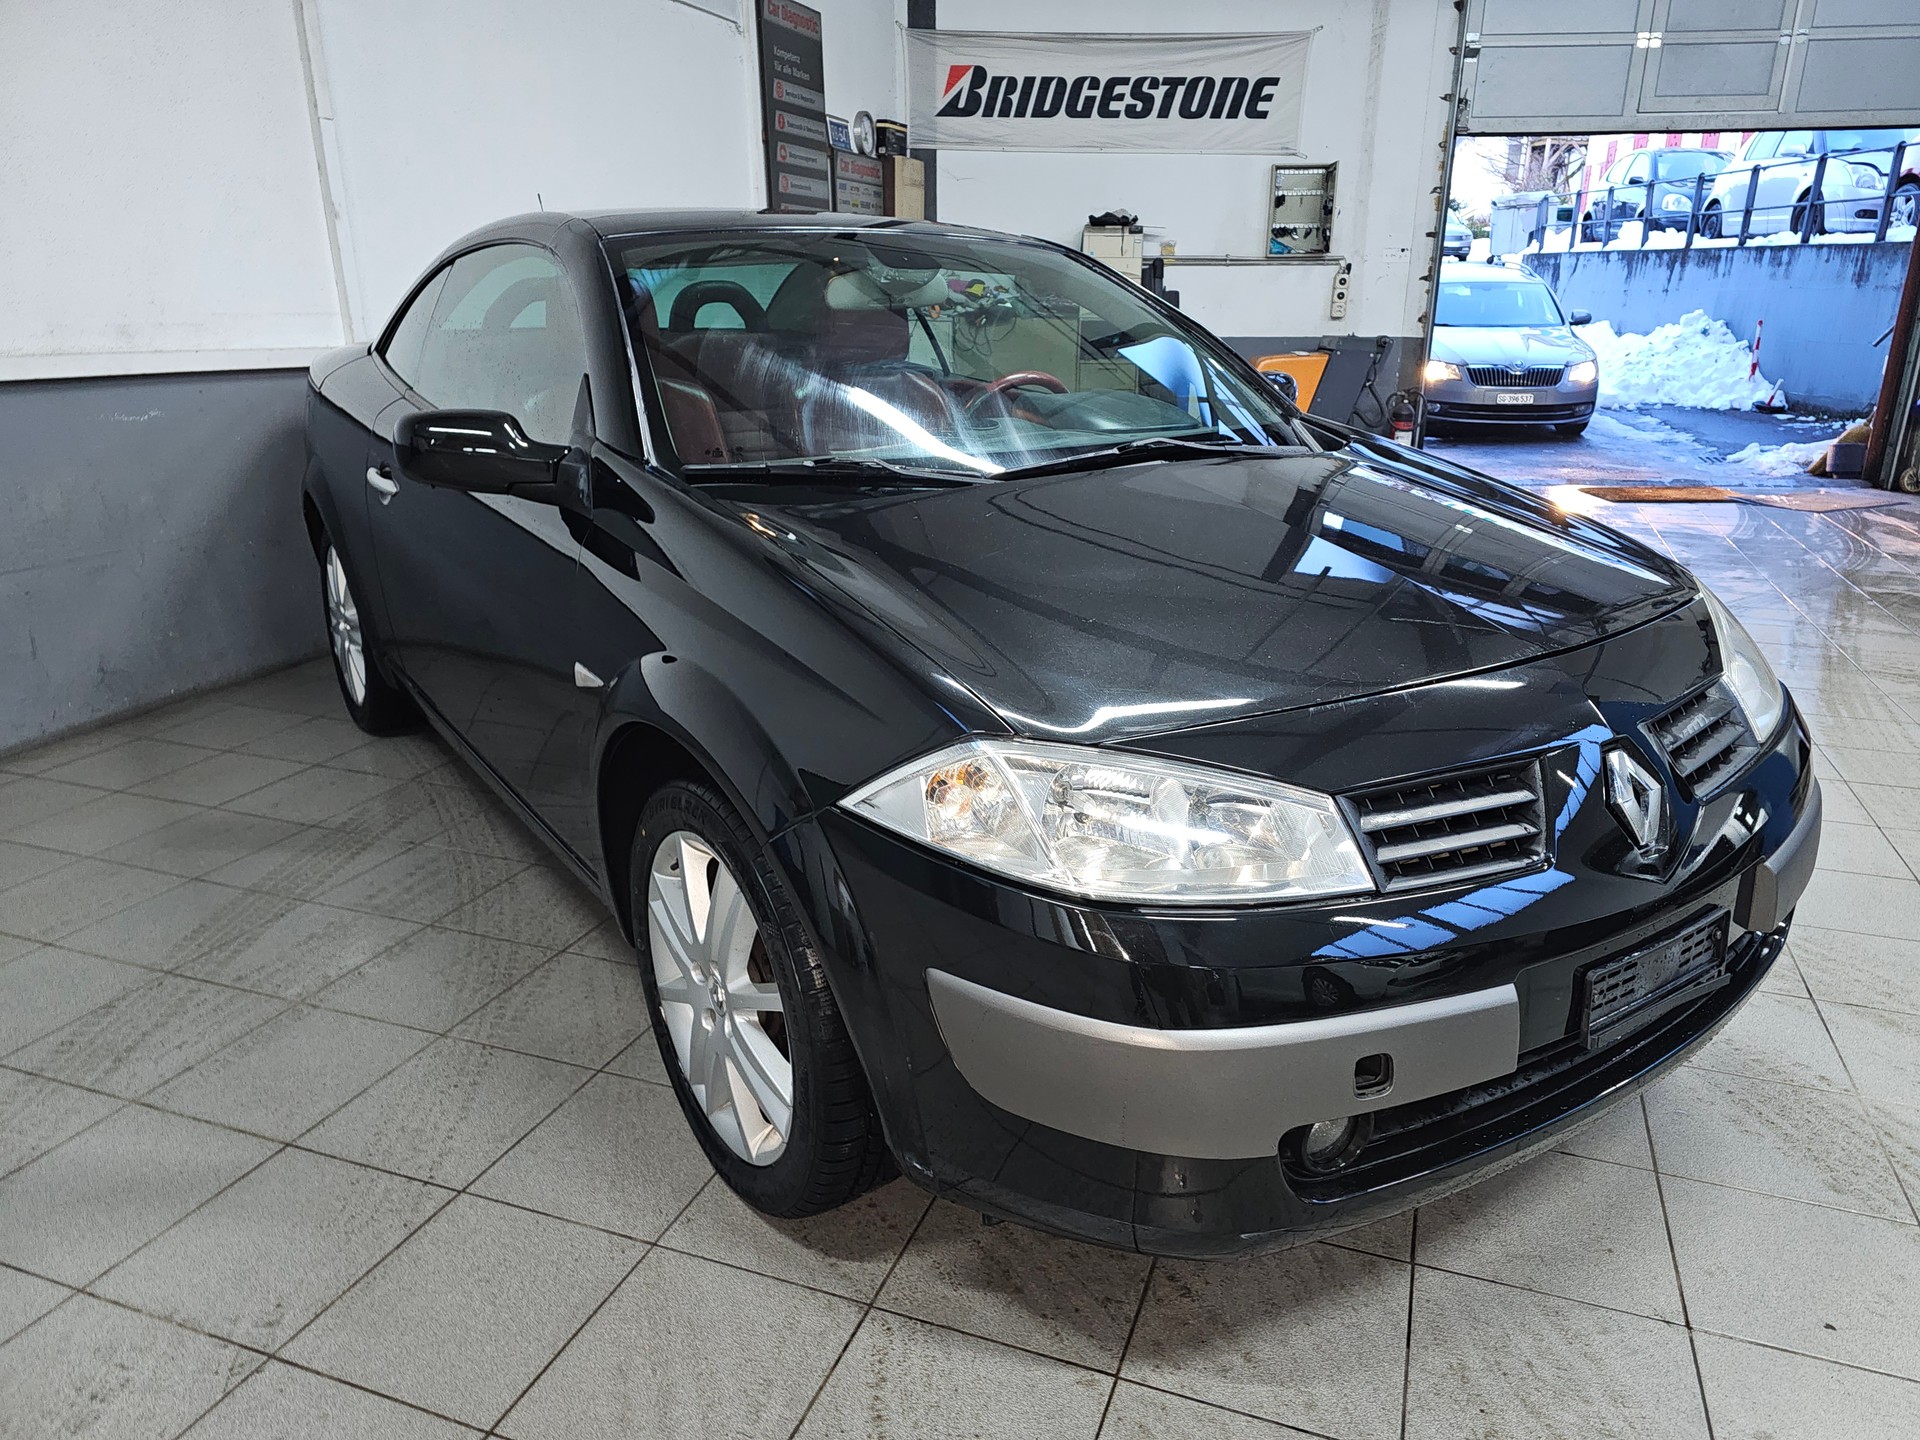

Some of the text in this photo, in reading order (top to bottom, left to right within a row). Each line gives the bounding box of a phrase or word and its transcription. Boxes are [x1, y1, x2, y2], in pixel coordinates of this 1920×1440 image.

[767, 0, 819, 34] Car Diagnostic
[934, 64, 1281, 119] BRIDGESTONE
